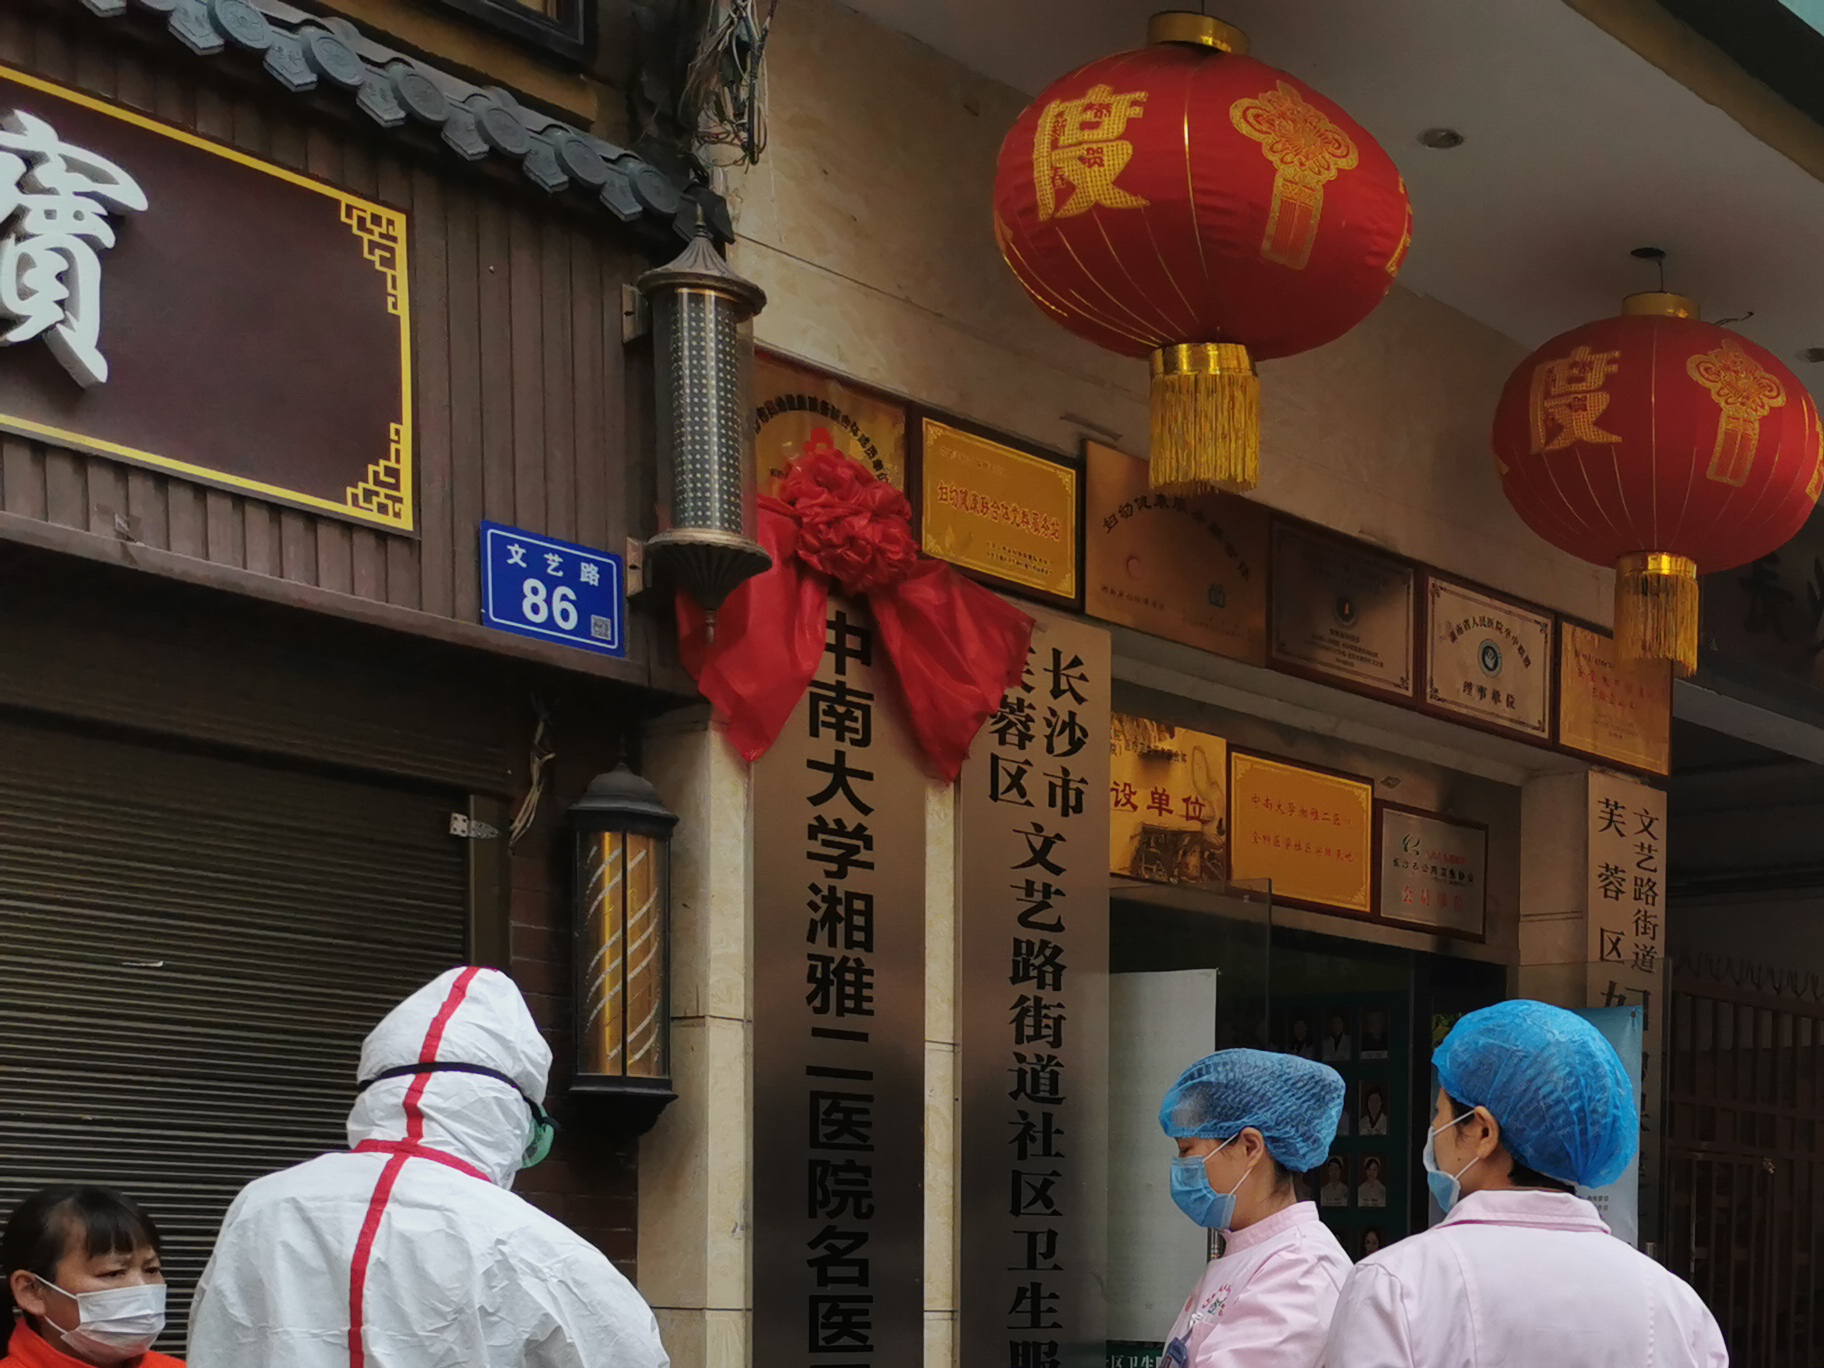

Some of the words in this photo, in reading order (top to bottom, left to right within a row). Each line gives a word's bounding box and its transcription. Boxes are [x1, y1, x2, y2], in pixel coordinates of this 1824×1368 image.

[1032, 84, 1152, 222] 度
[1529, 345, 1623, 455] 度
[506, 542, 600, 587] 文艺路
[520, 578, 579, 631] 86
[1043, 647, 1090, 818] 长沙市
[1110, 780, 1209, 825] 设单位
[1597, 797, 1627, 965] 芙蓉区
[1631, 808, 1660, 975] 文艺路街道
